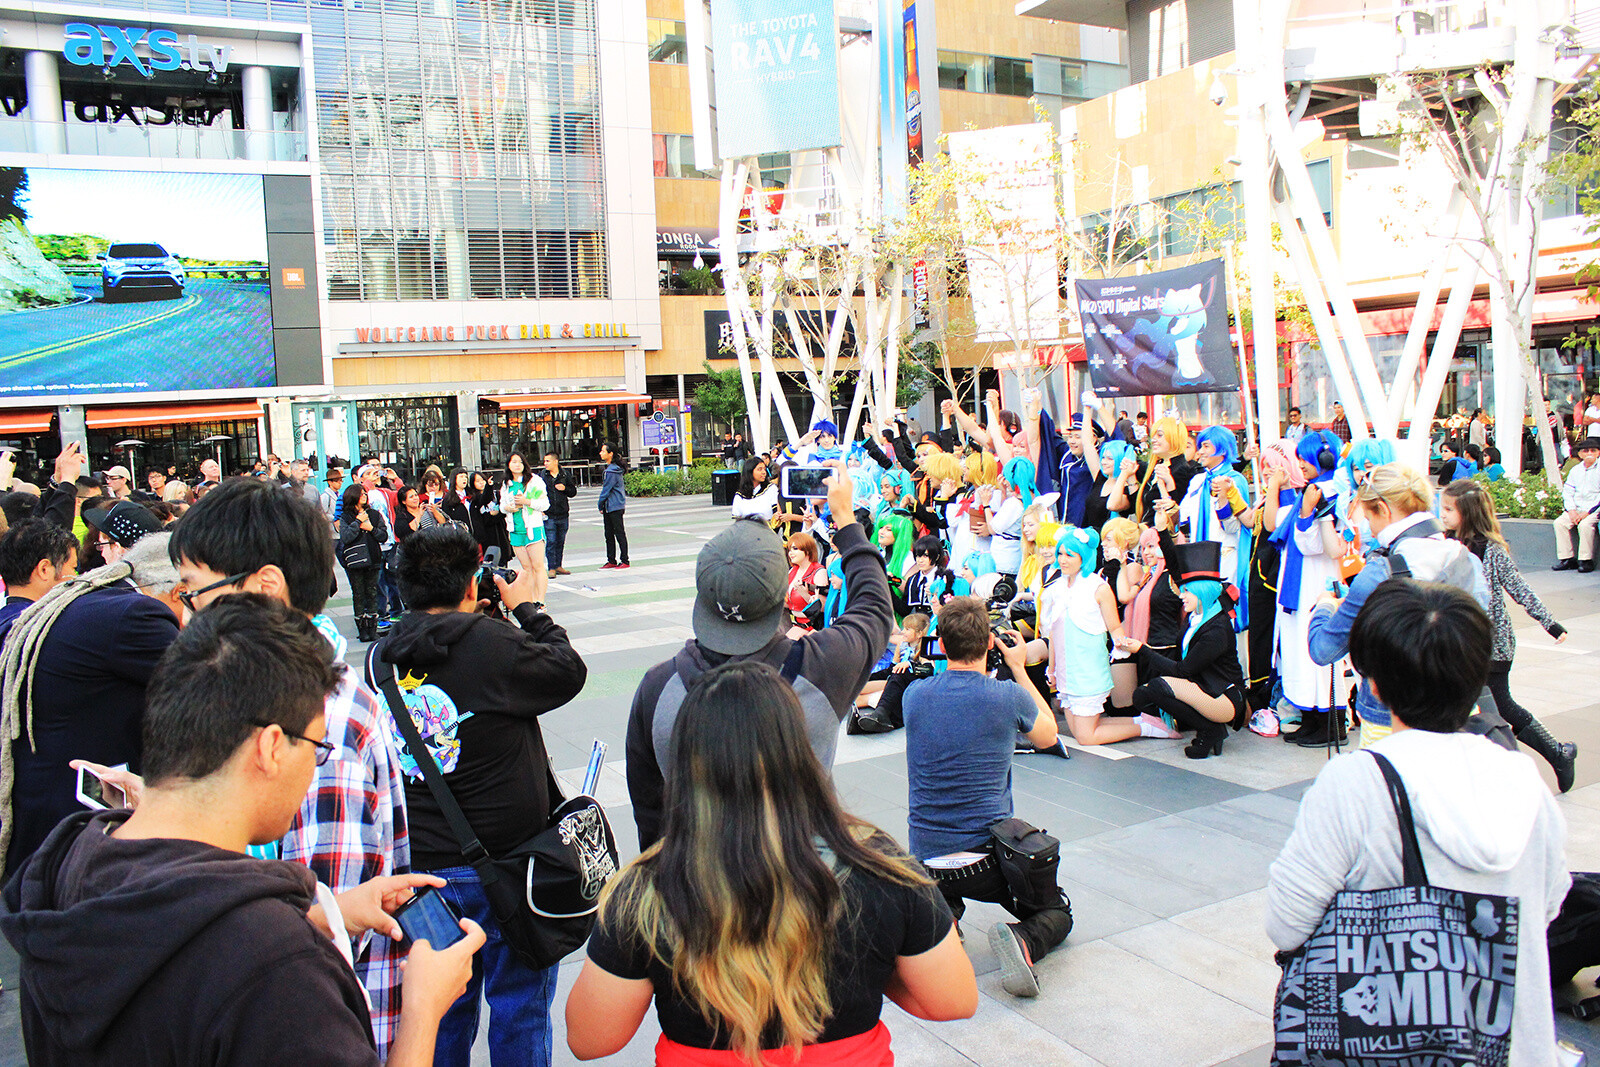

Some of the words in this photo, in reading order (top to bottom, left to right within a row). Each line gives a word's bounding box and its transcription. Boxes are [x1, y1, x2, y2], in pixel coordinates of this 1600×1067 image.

[730, 21, 758, 38] THE
[761, 12, 818, 33] TOYOTA
[731, 32, 821, 72] RAV4
[656, 232, 705, 245] CONGA
[1097, 299, 1115, 314] EXPO
[1115, 296, 1141, 316] Digital
[1142, 295, 1167, 310] Stars
[356, 326, 455, 343] WOLFGANG
[466, 325, 509, 341] PUCK
[520, 324, 551, 339] BAR
[560, 323, 574, 338] &
[583, 323, 630, 338] GRILL
[1337, 886, 1417, 909] MEGURINE
[1420, 886, 1466, 910] LUKA
[1337, 909, 1379, 918] FUKUOKA
[1380, 903, 1440, 920] KAGAMINE
[1443, 907, 1467, 922] RIN
[1337, 924, 1379, 935] NAGOYA
[1380, 916, 1442, 932] KAGAMINE
[1443, 920, 1468, 935] LEN
[1337, 930, 1517, 985] HATSUNE
[1306, 974, 1314, 1014] TOKYO
[1376, 971, 1515, 1036] MIKU
[1307, 1041, 1341, 1050] TOKYO
[1344, 1033, 1403, 1057] MIKU
[1406, 1028, 1474, 1049] EXPO
